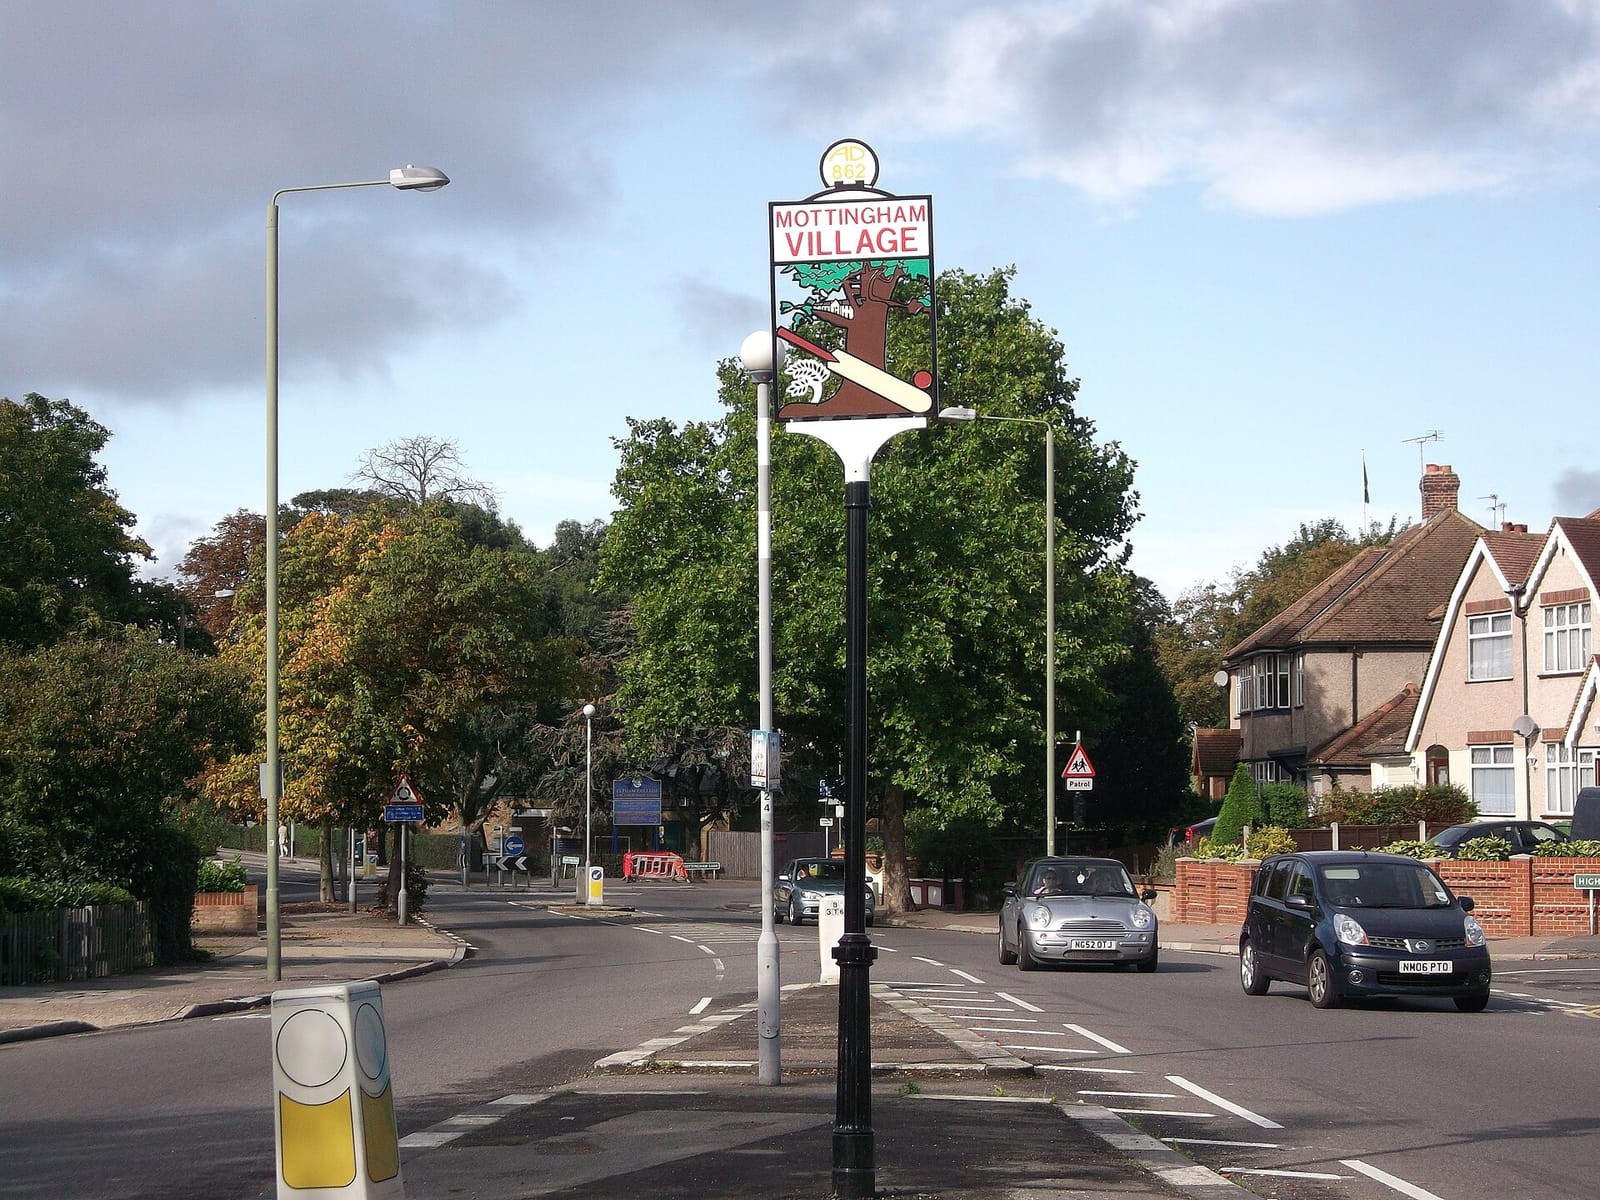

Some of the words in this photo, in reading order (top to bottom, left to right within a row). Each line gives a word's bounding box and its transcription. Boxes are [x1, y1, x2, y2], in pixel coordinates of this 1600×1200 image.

[829, 146, 866, 161] AD
[832, 163, 866, 179] 862
[775, 205, 926, 228] MOTTINGHAM
[785, 227, 918, 256] VILLAGE
[1578, 877, 1600, 885] HIGH
[1402, 962, 1428, 972] NM06
[1430, 962, 1449, 972] PTO
